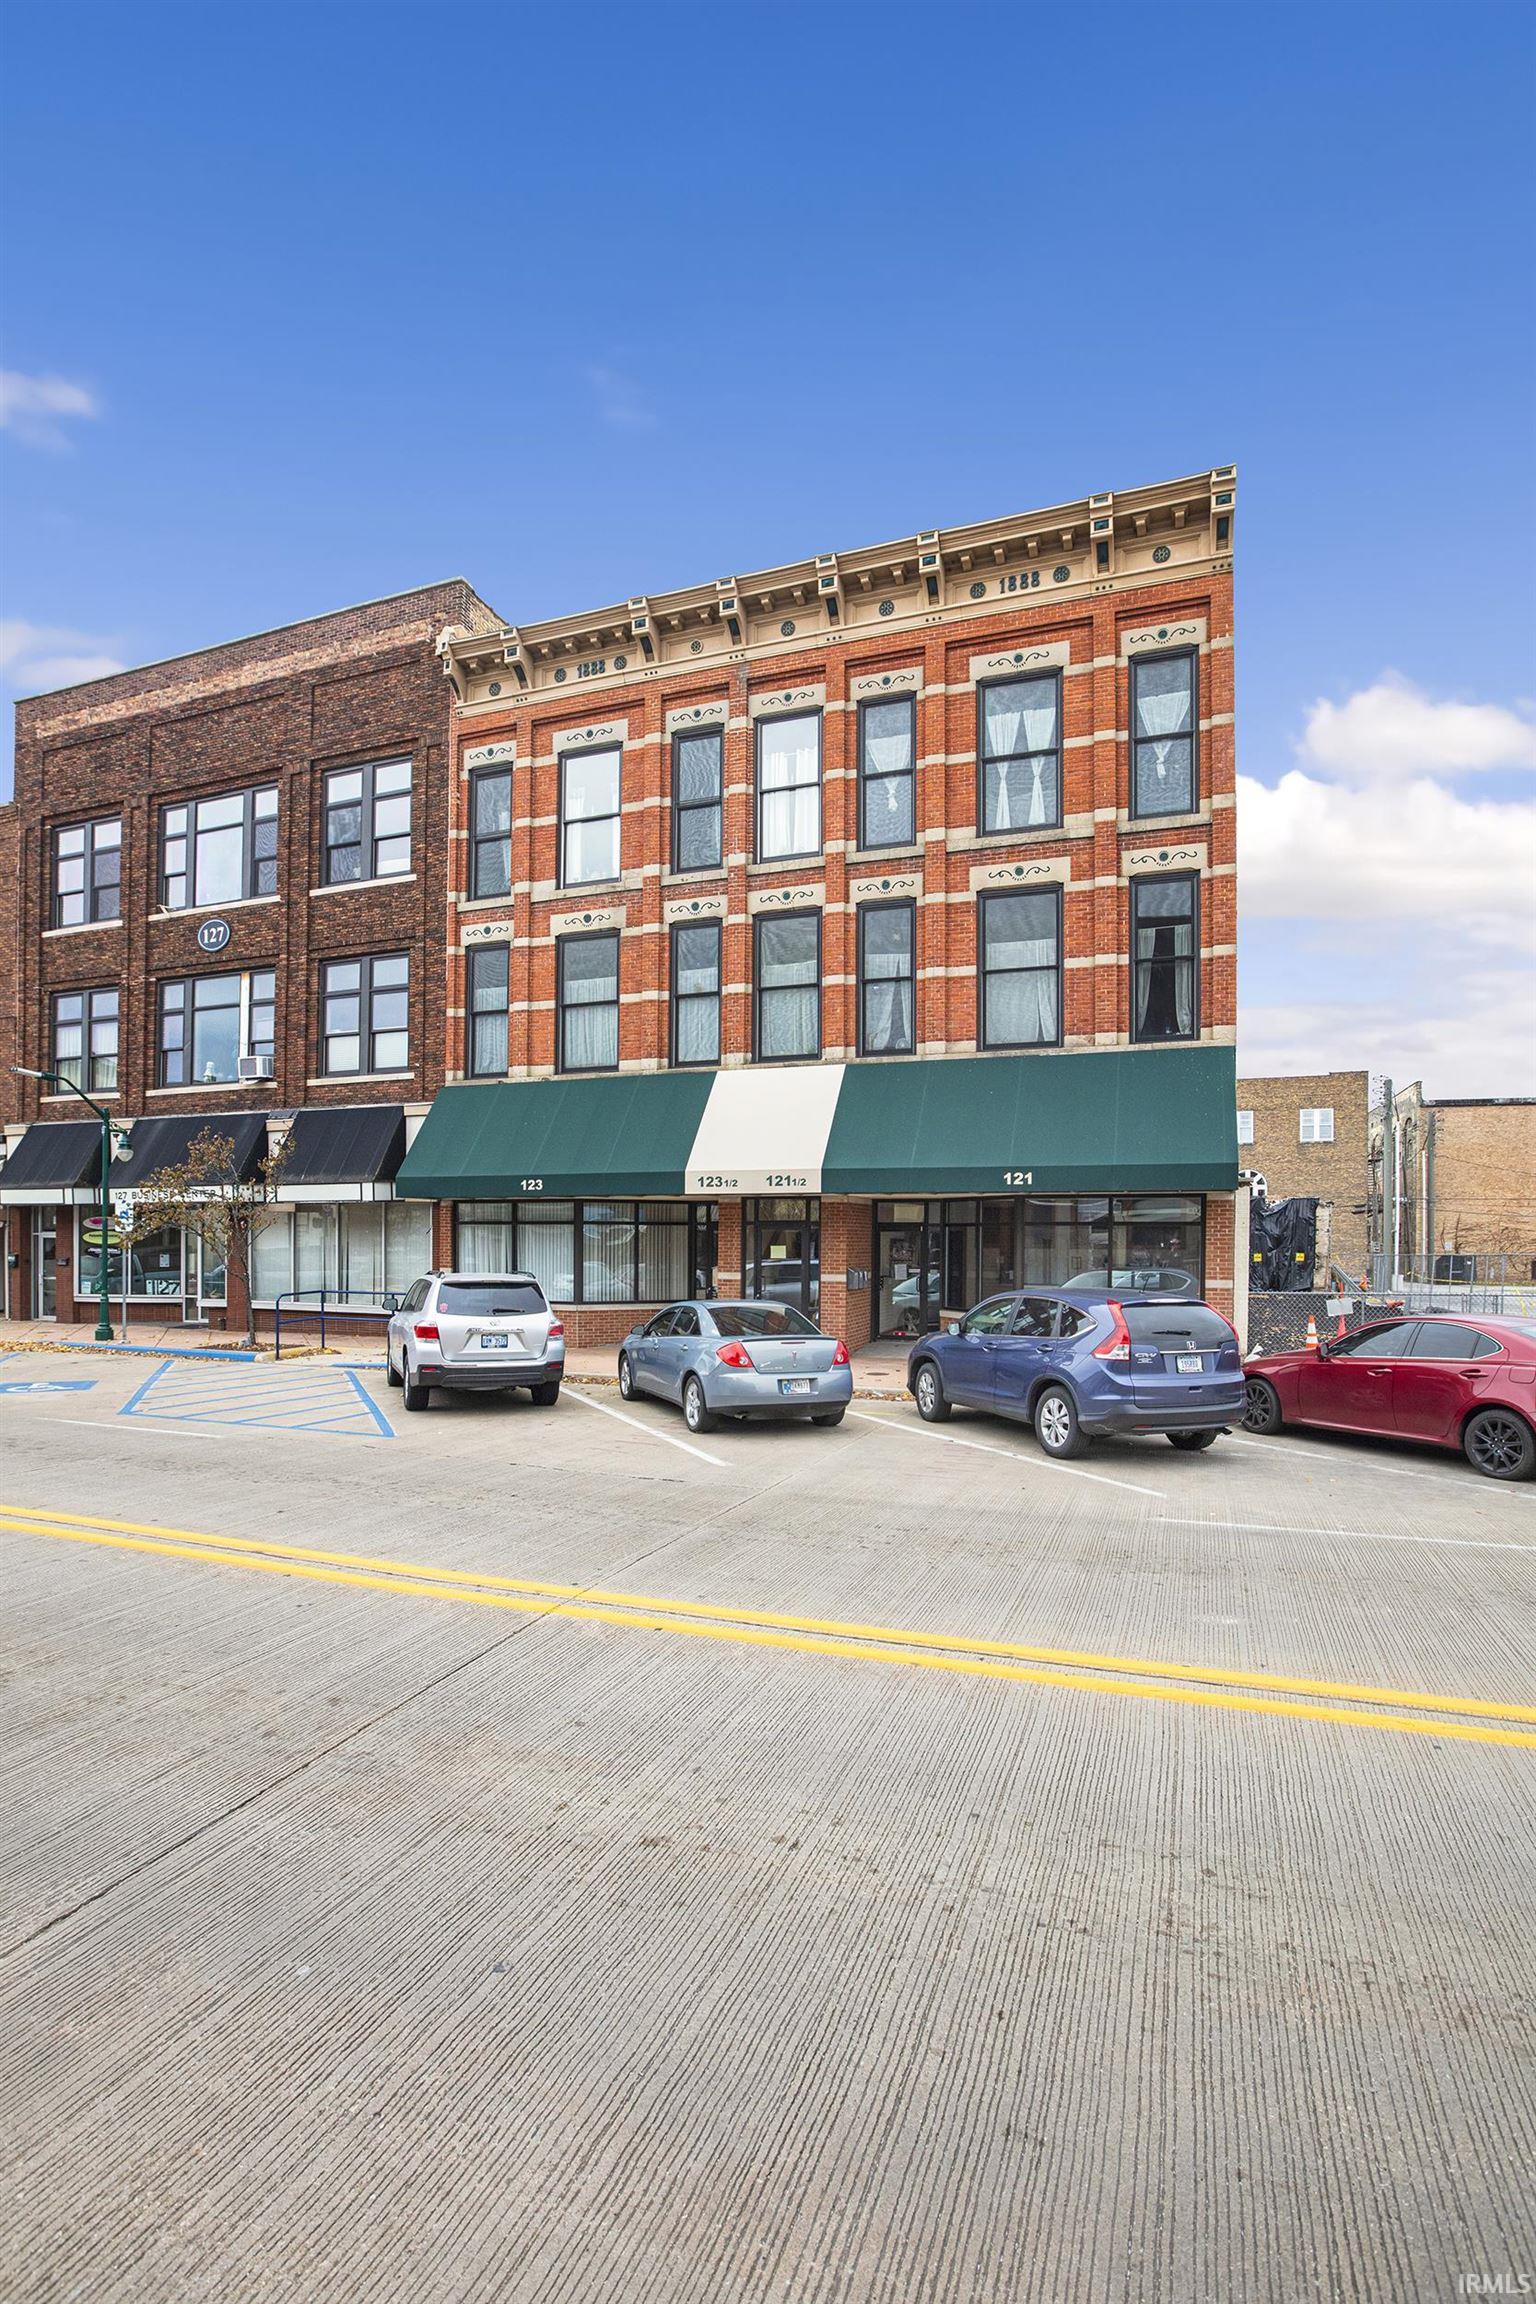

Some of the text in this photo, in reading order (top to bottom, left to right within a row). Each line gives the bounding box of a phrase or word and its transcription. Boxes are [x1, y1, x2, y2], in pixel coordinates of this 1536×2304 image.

[999, 570, 1040, 594] 1888
[577, 660, 605, 678] 1888
[203, 926, 224, 944] 127
[520, 1179, 543, 1191] 123
[1003, 1172, 1032, 1185] 121
[114, 1191, 128, 1200] 127
[131, 1190, 173, 1200] BUSINES
